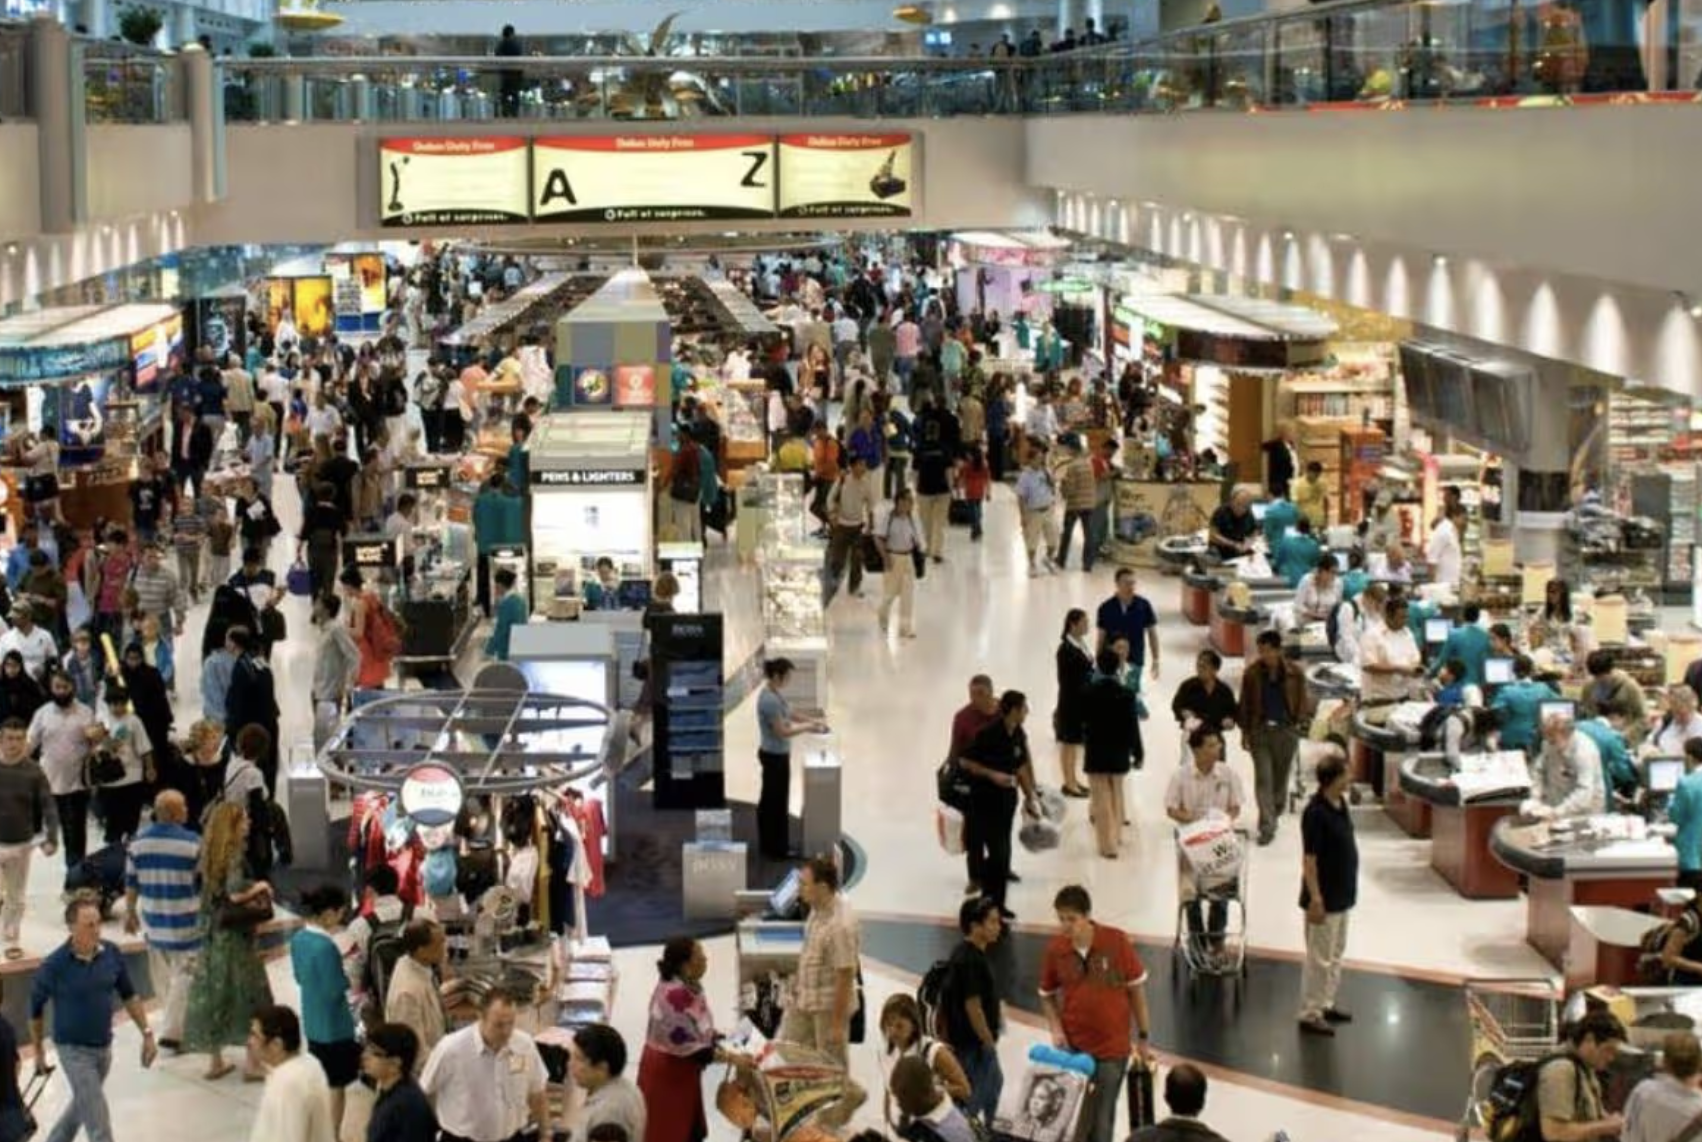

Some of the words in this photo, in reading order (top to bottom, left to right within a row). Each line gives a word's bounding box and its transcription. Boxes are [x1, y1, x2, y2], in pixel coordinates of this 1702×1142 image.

[540, 167, 577, 206] A
[740, 151, 768, 187] Z
[541, 471, 569, 482] PENS
[572, 471, 580, 482] &
[583, 471, 635, 482] LIGHTERS
